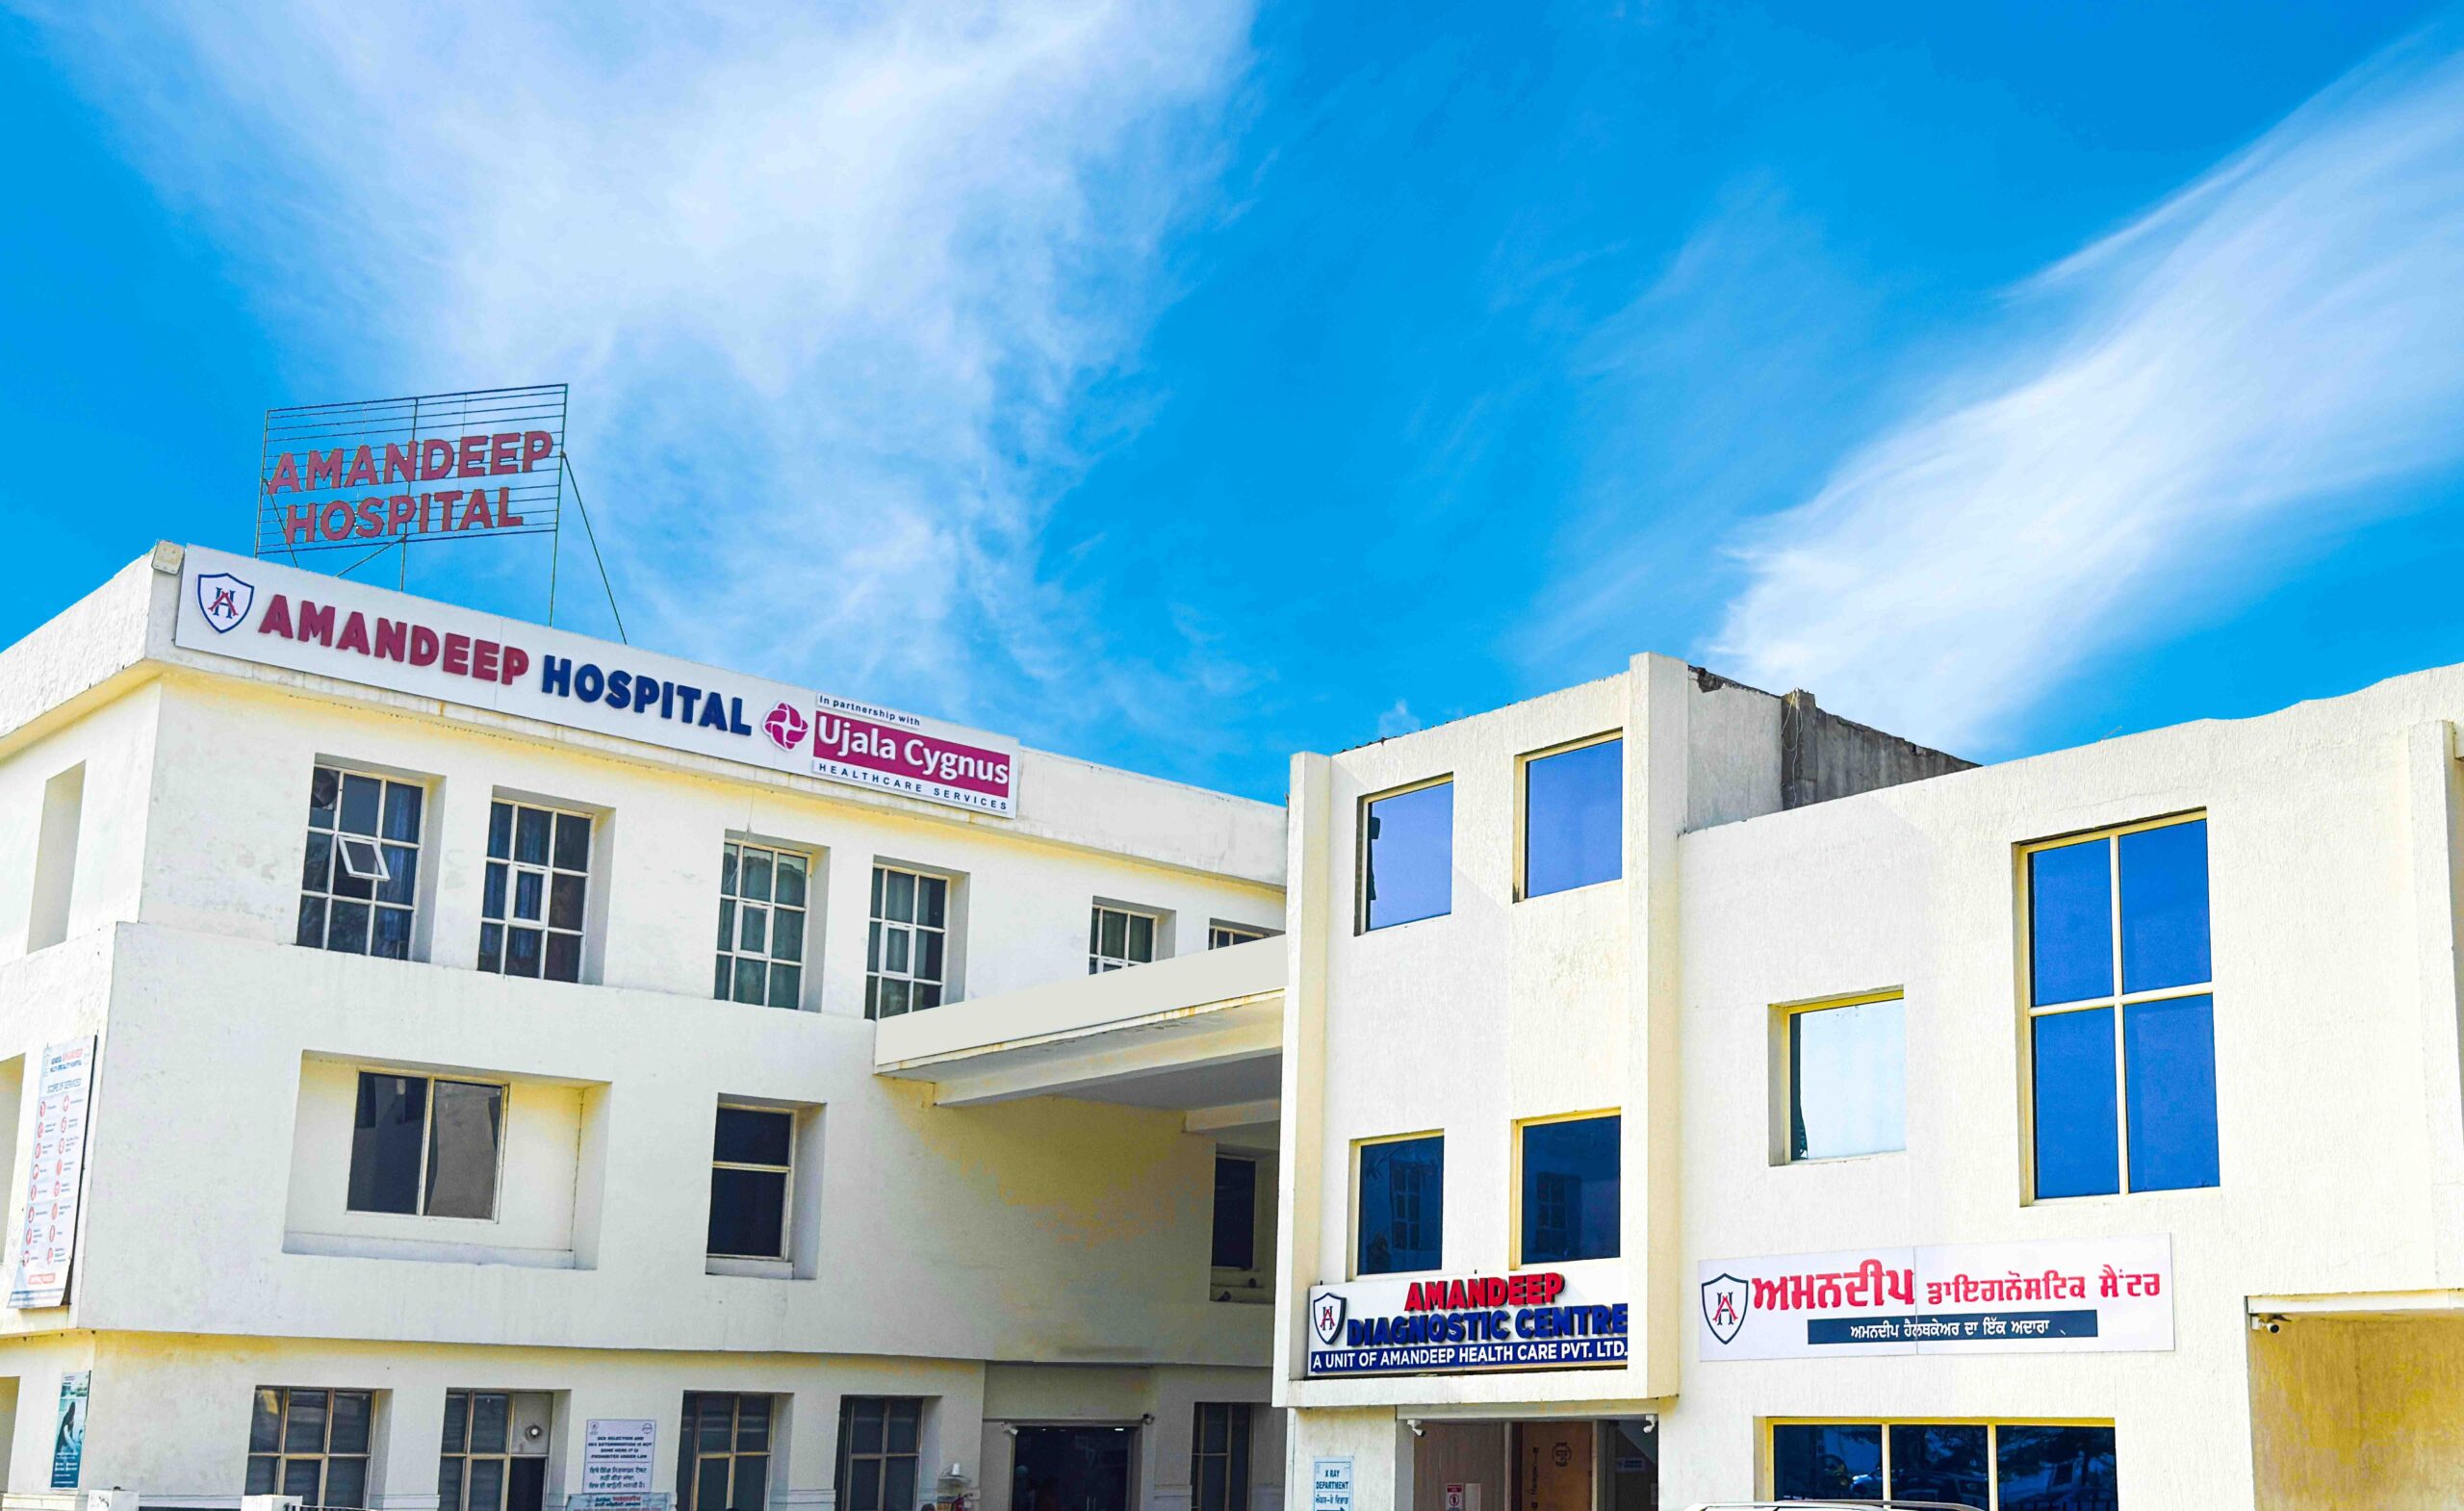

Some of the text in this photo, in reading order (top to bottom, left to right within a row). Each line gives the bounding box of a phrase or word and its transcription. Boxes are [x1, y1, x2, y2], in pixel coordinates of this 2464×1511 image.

[267, 430, 553, 495] AMANDEEP
[285, 487, 524, 545] HOSPITAL
[258, 594, 753, 735] AMANDEEP HOSPITAL
[819, 695, 920, 727] In partnership with
[819, 715, 1009, 784] Ujala Cygnus
[819, 763, 1007, 810] HEALTHCARE SERVICES
[1404, 1272, 1565, 1312] AMANDEEP
[1751, 1259, 1915, 1311] ਅਮਨਦੀਪ
[1927, 1269, 2086, 1305] ਡਾਇਗਨੋਸਟਿਕ
[1348, 1303, 1629, 1346] DIAGNOSTIC CENTRE
[1850, 1319, 1900, 1339] ਅਮਨਦੀਪ
[1964, 1321, 1978, 1336] ਦਾ
[2011, 1319, 2050, 1335] ਅਦਾਰਾ
[1312, 1341, 1629, 1369] A UNIT OF AMANDEEP HEALTH CARE PVT. LTD.
[1316, 1481, 1349, 1490] DEPARTMENT
